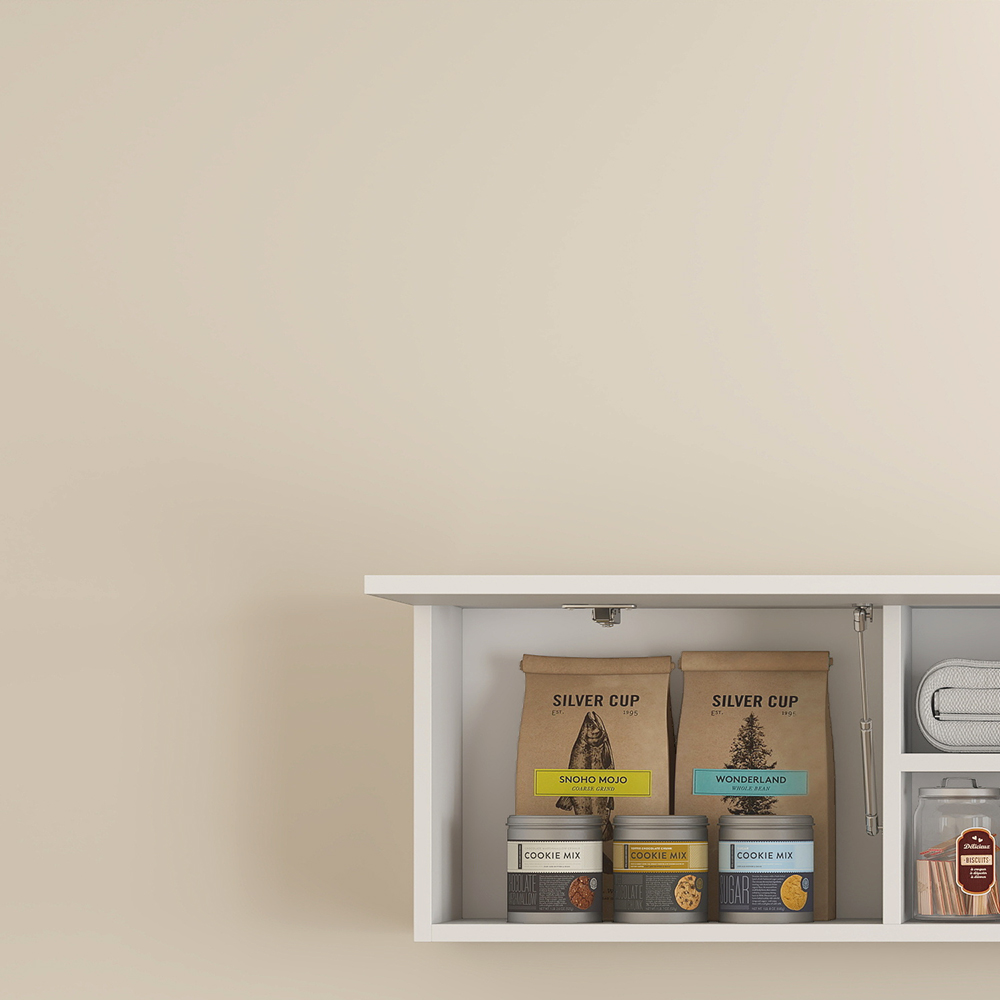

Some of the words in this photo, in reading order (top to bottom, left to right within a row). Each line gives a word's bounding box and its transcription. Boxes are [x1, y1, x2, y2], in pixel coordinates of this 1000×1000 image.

[553, 694, 603, 706] SILVER
[609, 694, 640, 706] CUP
[712, 695, 762, 707] SILVER
[768, 695, 798, 708] CUP
[716, 776, 787, 784] WONDERLAND
